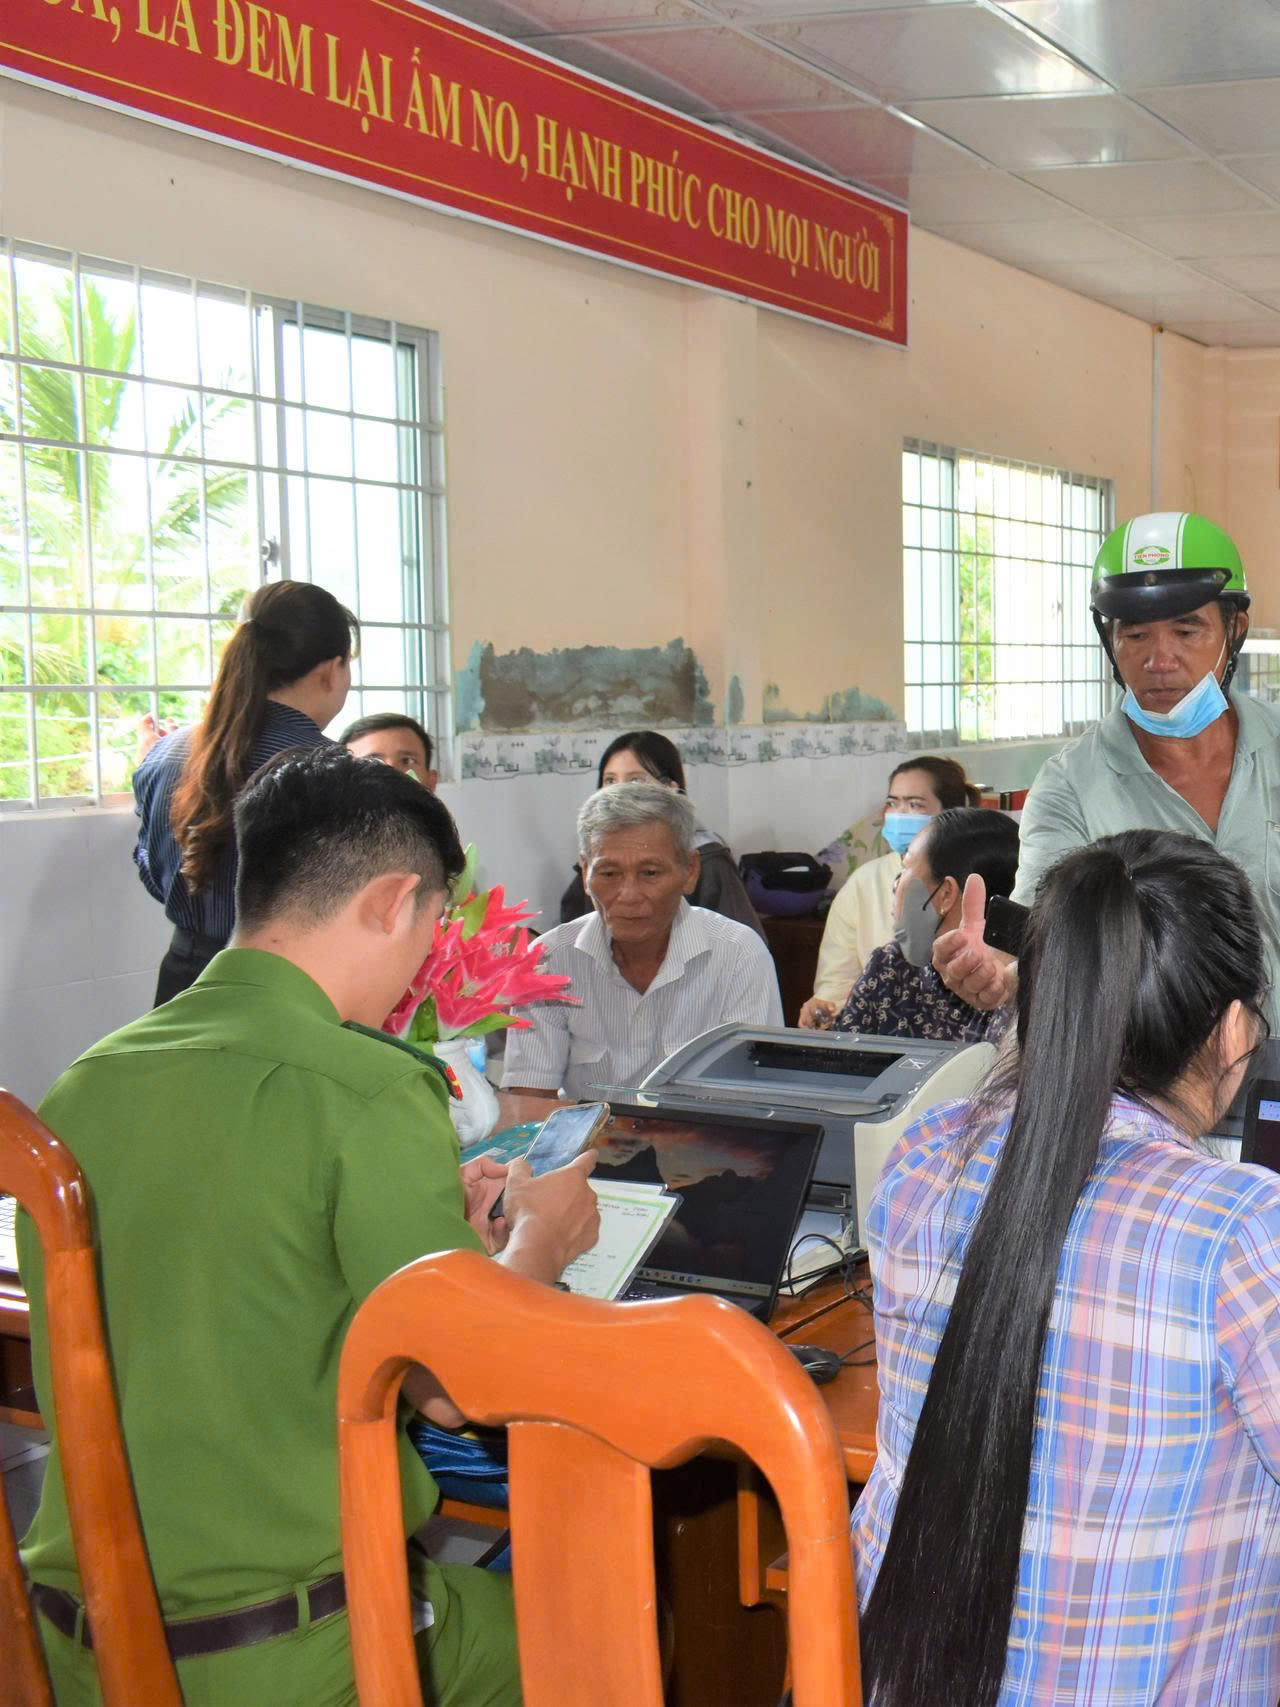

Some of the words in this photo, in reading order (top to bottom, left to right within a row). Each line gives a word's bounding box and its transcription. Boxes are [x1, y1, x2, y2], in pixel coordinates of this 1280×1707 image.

[213, 0, 314, 95] ĐEM
[325, 32, 394, 134] LẠI
[404, 47, 462, 147] ẤM
[470, 89, 528, 182] NO,
[536, 114, 622, 202] HẠNH
[630, 149, 701, 229] PHÚC
[708, 183, 760, 249] CHO
[765, 203, 809, 278] MỌI
[815, 223, 880, 293] NGƯỜI
